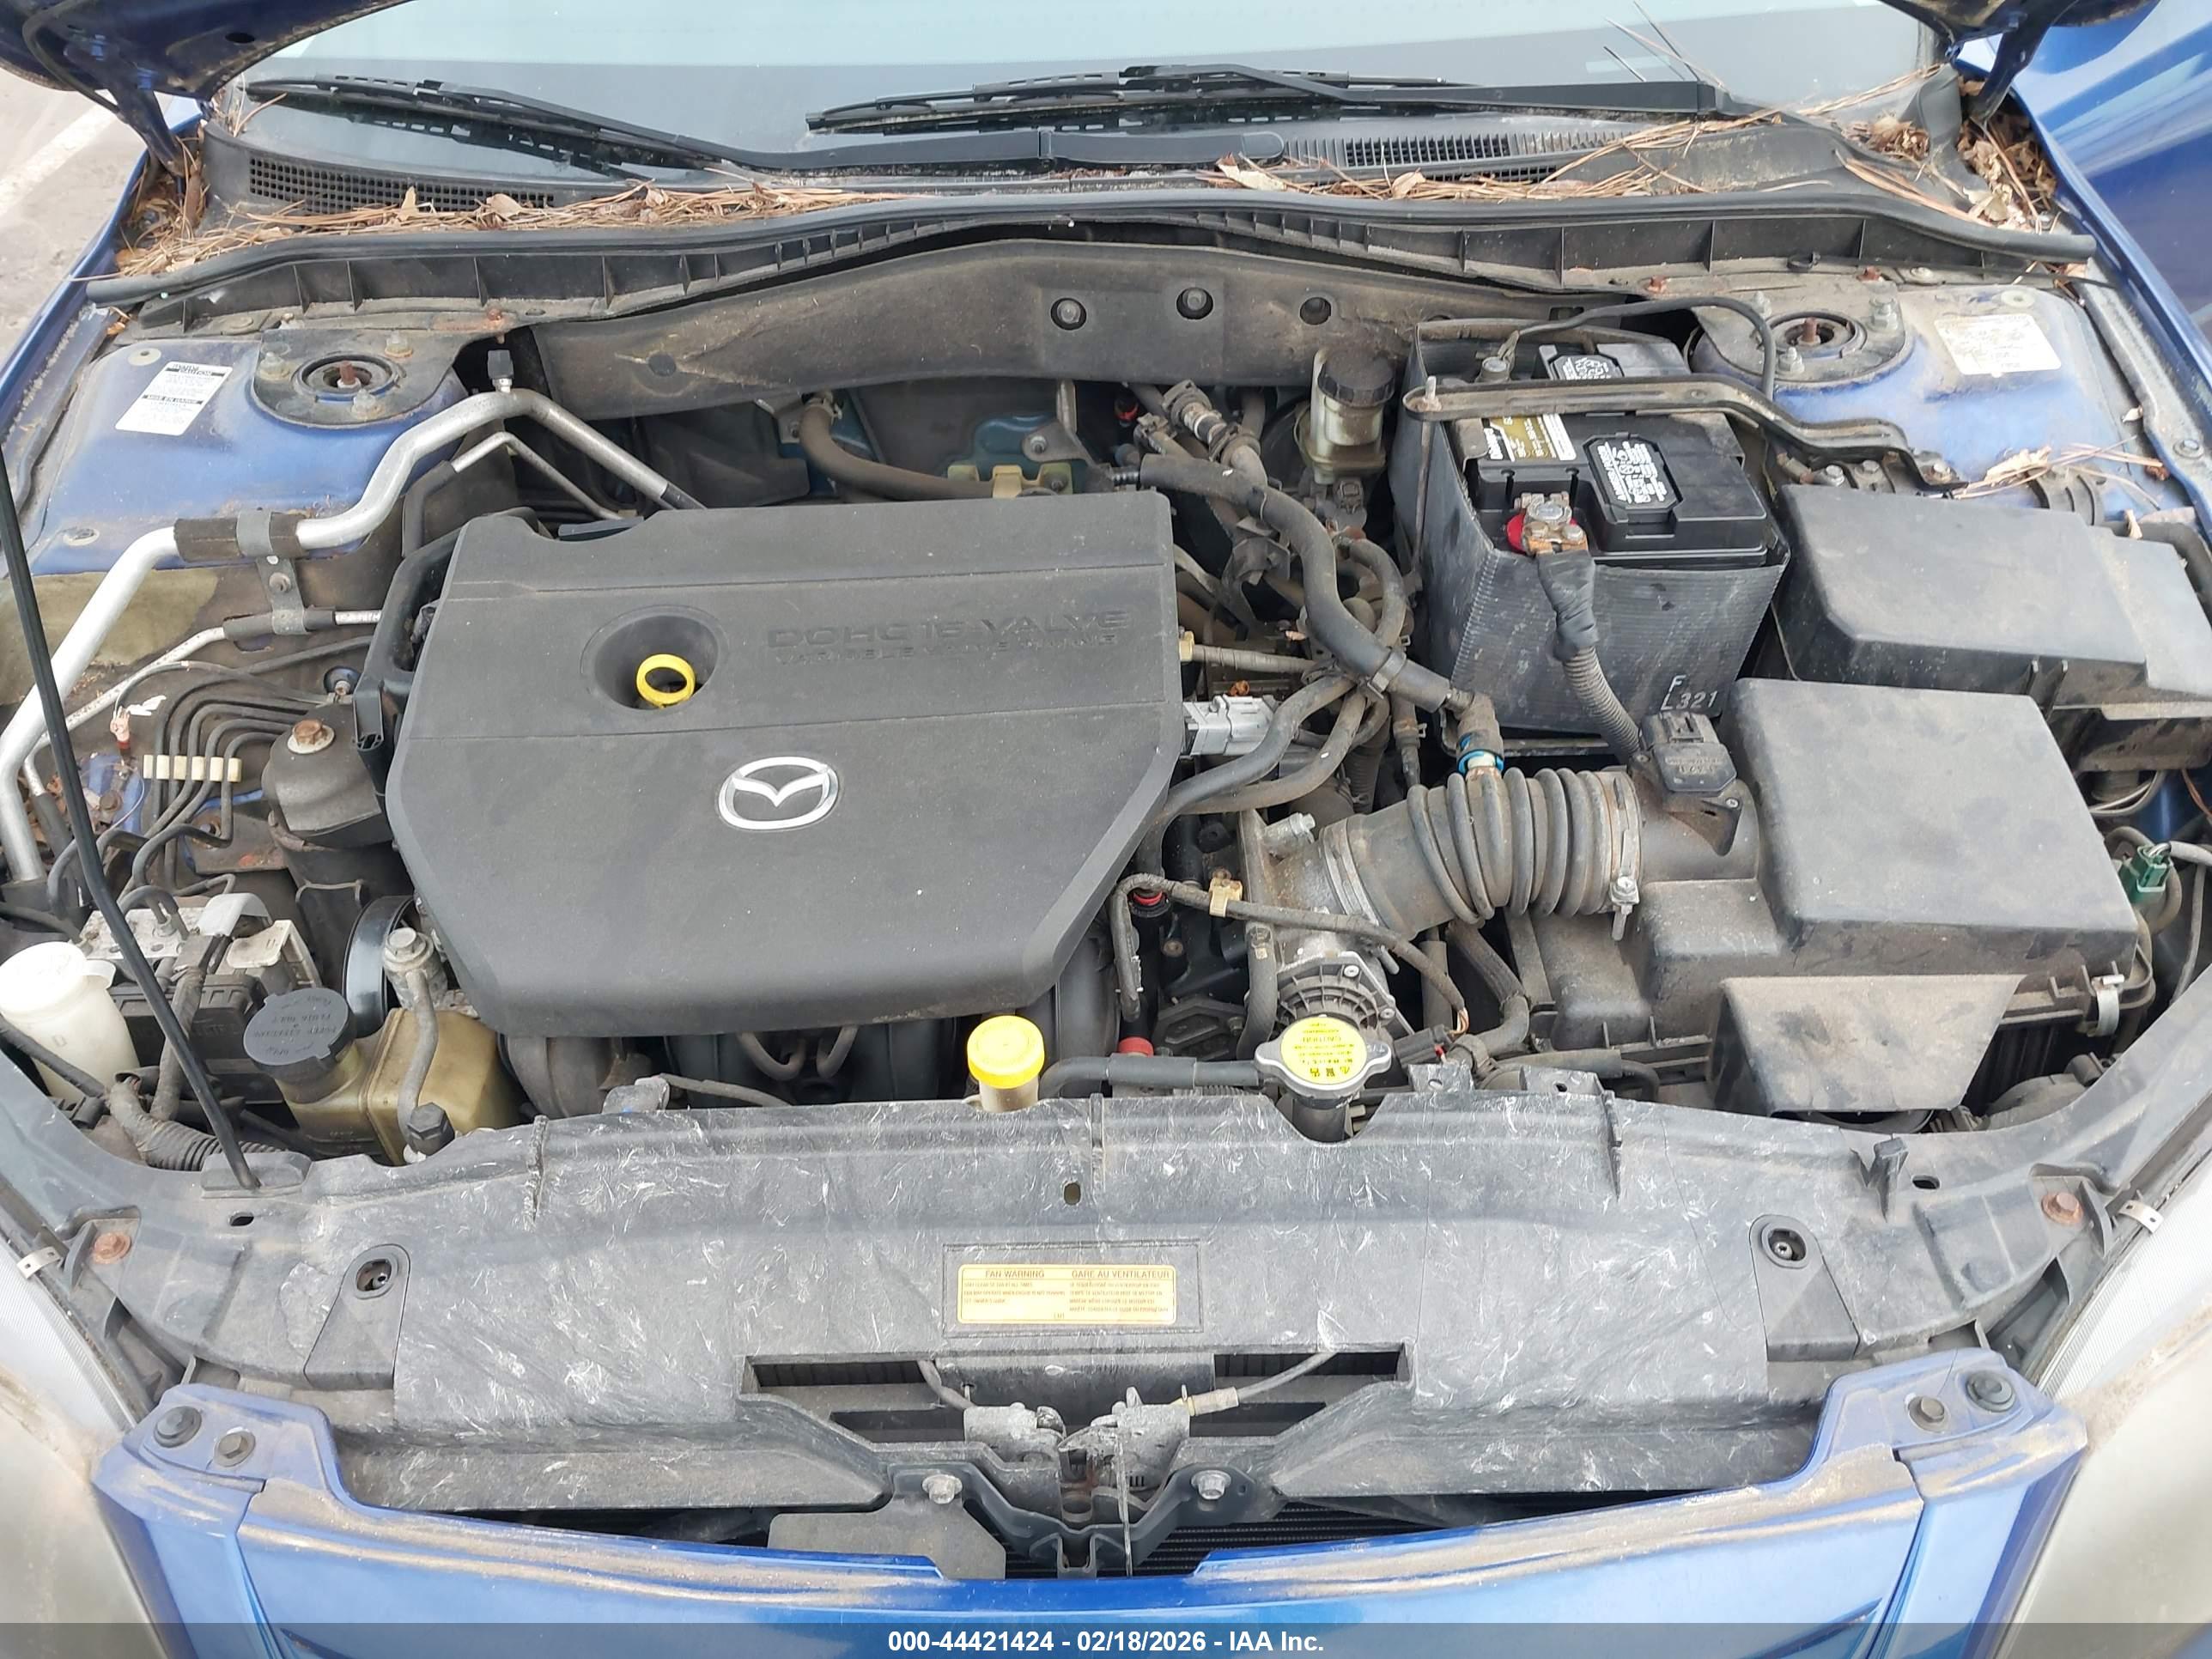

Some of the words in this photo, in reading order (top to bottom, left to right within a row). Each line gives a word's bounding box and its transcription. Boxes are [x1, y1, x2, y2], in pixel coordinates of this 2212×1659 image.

[767, 622, 909, 648] DOHC
[985, 1269, 1002, 1279] FAN
[1004, 1269, 1045, 1279] WARNING
[1097, 1269, 1110, 1279] AU
[1112, 1269, 1170, 1279] VENTILATEUR
